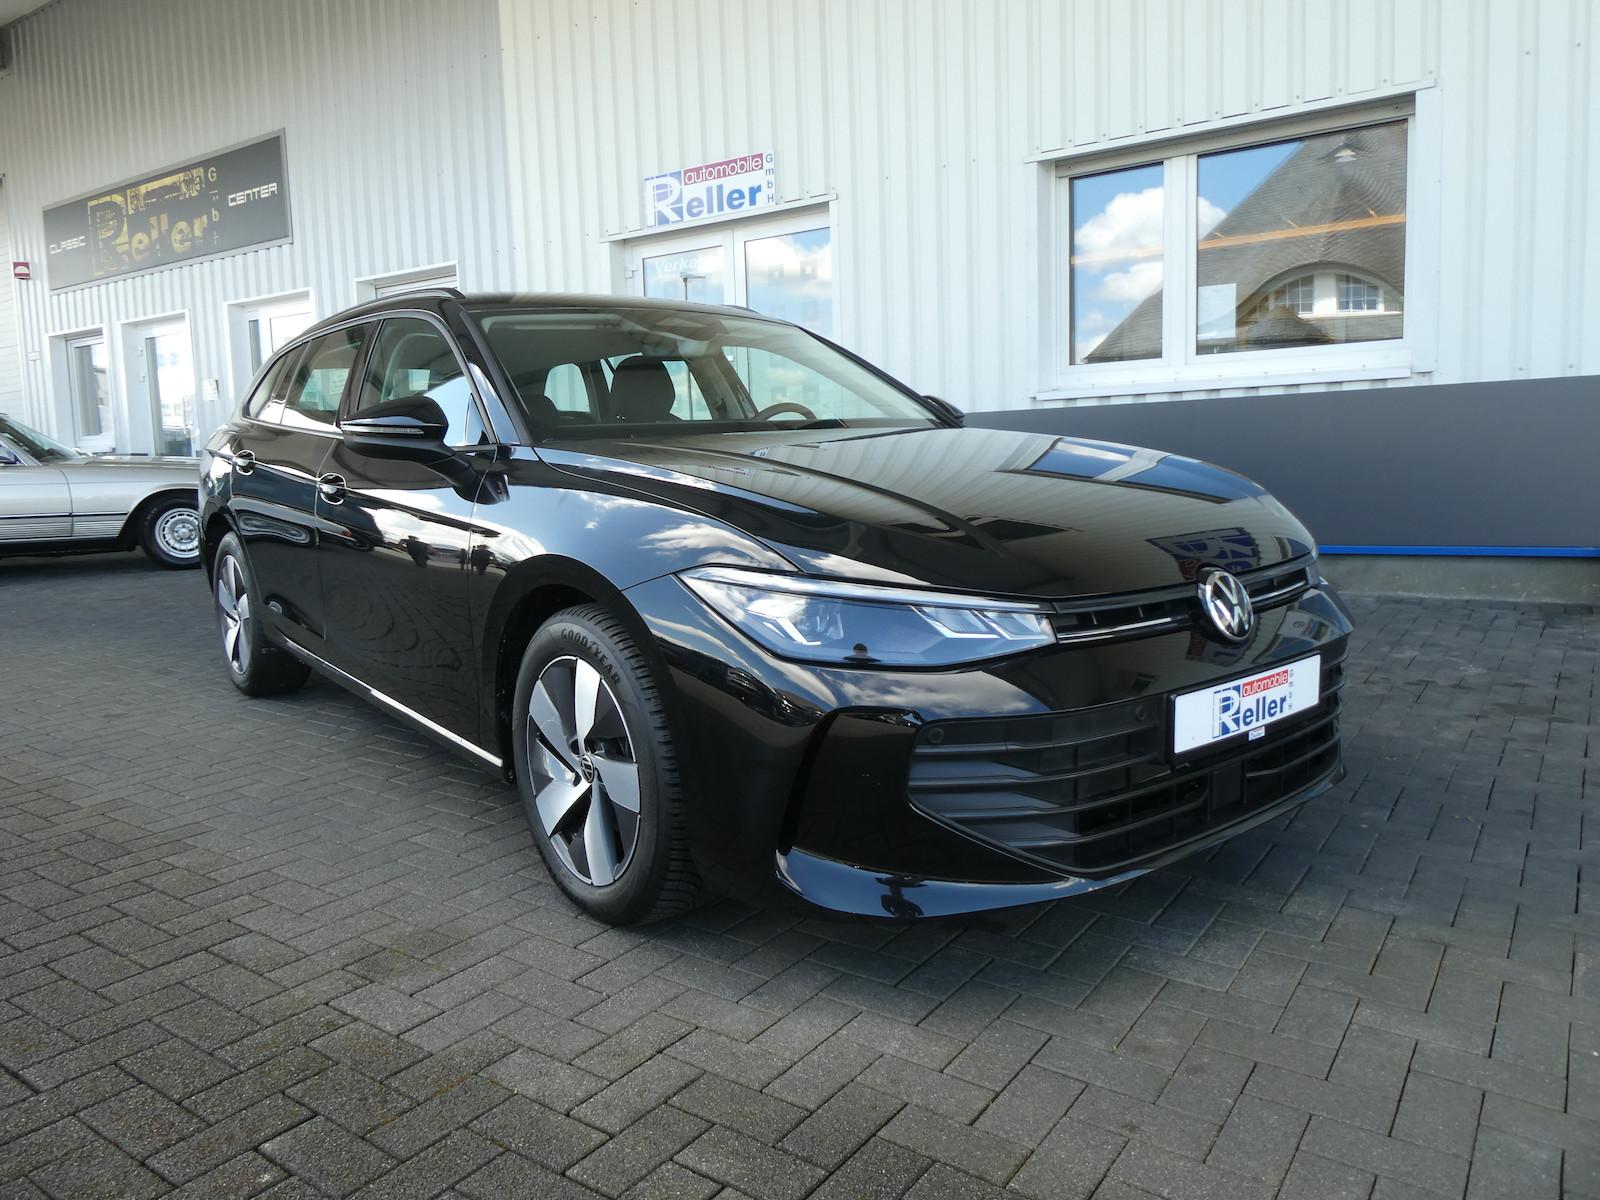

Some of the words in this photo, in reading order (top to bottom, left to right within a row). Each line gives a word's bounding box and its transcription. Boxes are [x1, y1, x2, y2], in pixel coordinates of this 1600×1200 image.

[685, 156, 762, 184] automobile
[228, 183, 278, 206] CENTER
[644, 171, 762, 228] Reller
[560, 628, 621, 685] GOODYEAR
[1242, 670, 1288, 697] automobile
[1212, 684, 1287, 739] Reller
